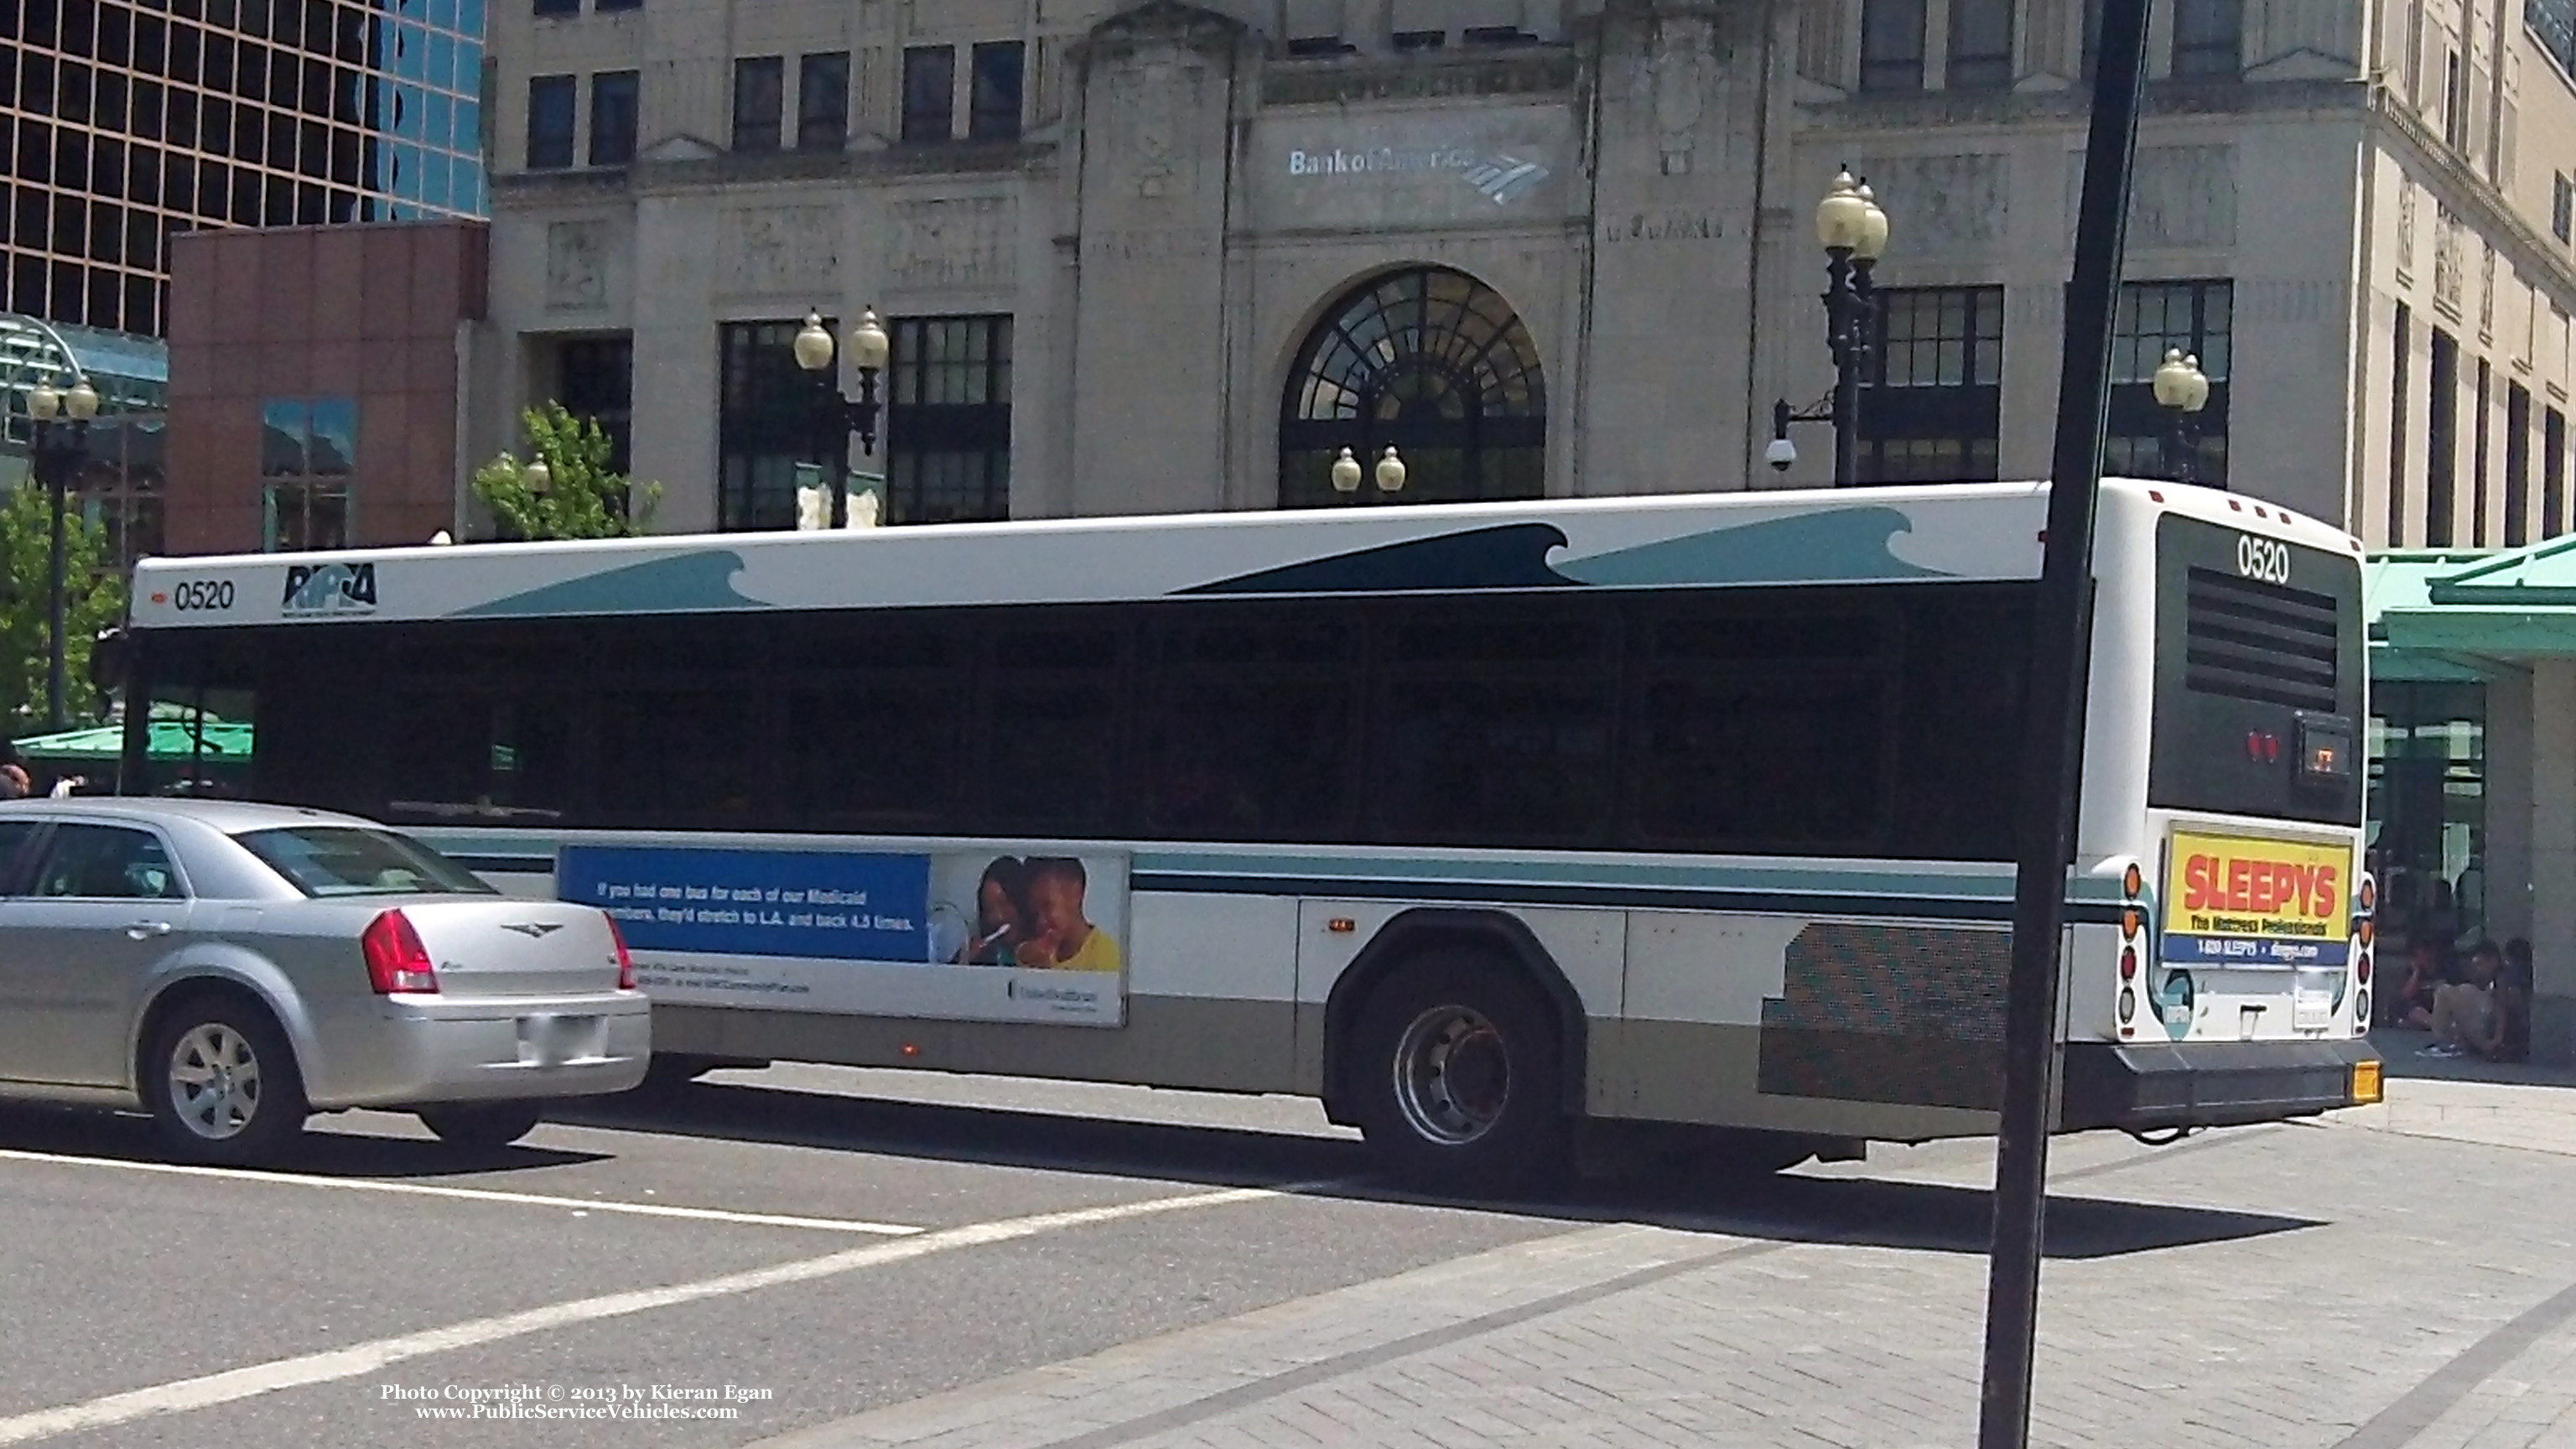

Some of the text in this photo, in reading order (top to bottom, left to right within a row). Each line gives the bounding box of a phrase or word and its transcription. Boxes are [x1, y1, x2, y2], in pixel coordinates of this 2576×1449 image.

[1290, 149, 1347, 176] Bank
[1379, 144, 1475, 172] Arica
[2238, 534, 2289, 584] 0520
[174, 580, 235, 610] 0520
[609, 885, 631, 900] you
[633, 883, 657, 898] had
[659, 886, 683, 899] one
[685, 885, 709, 901] bus
[711, 885, 730, 901] for
[732, 887, 762, 902] each
[765, 887, 781, 902] of
[782, 892, 805, 903] our
[807, 888, 868, 906] Medicaid
[657, 906, 695, 925] they'd
[697, 909, 740, 924] stretch
[743, 911, 757, 925] to
[788, 913, 813, 927] and
[816, 913, 847, 928] back
[850, 914, 870, 929] 4.5
